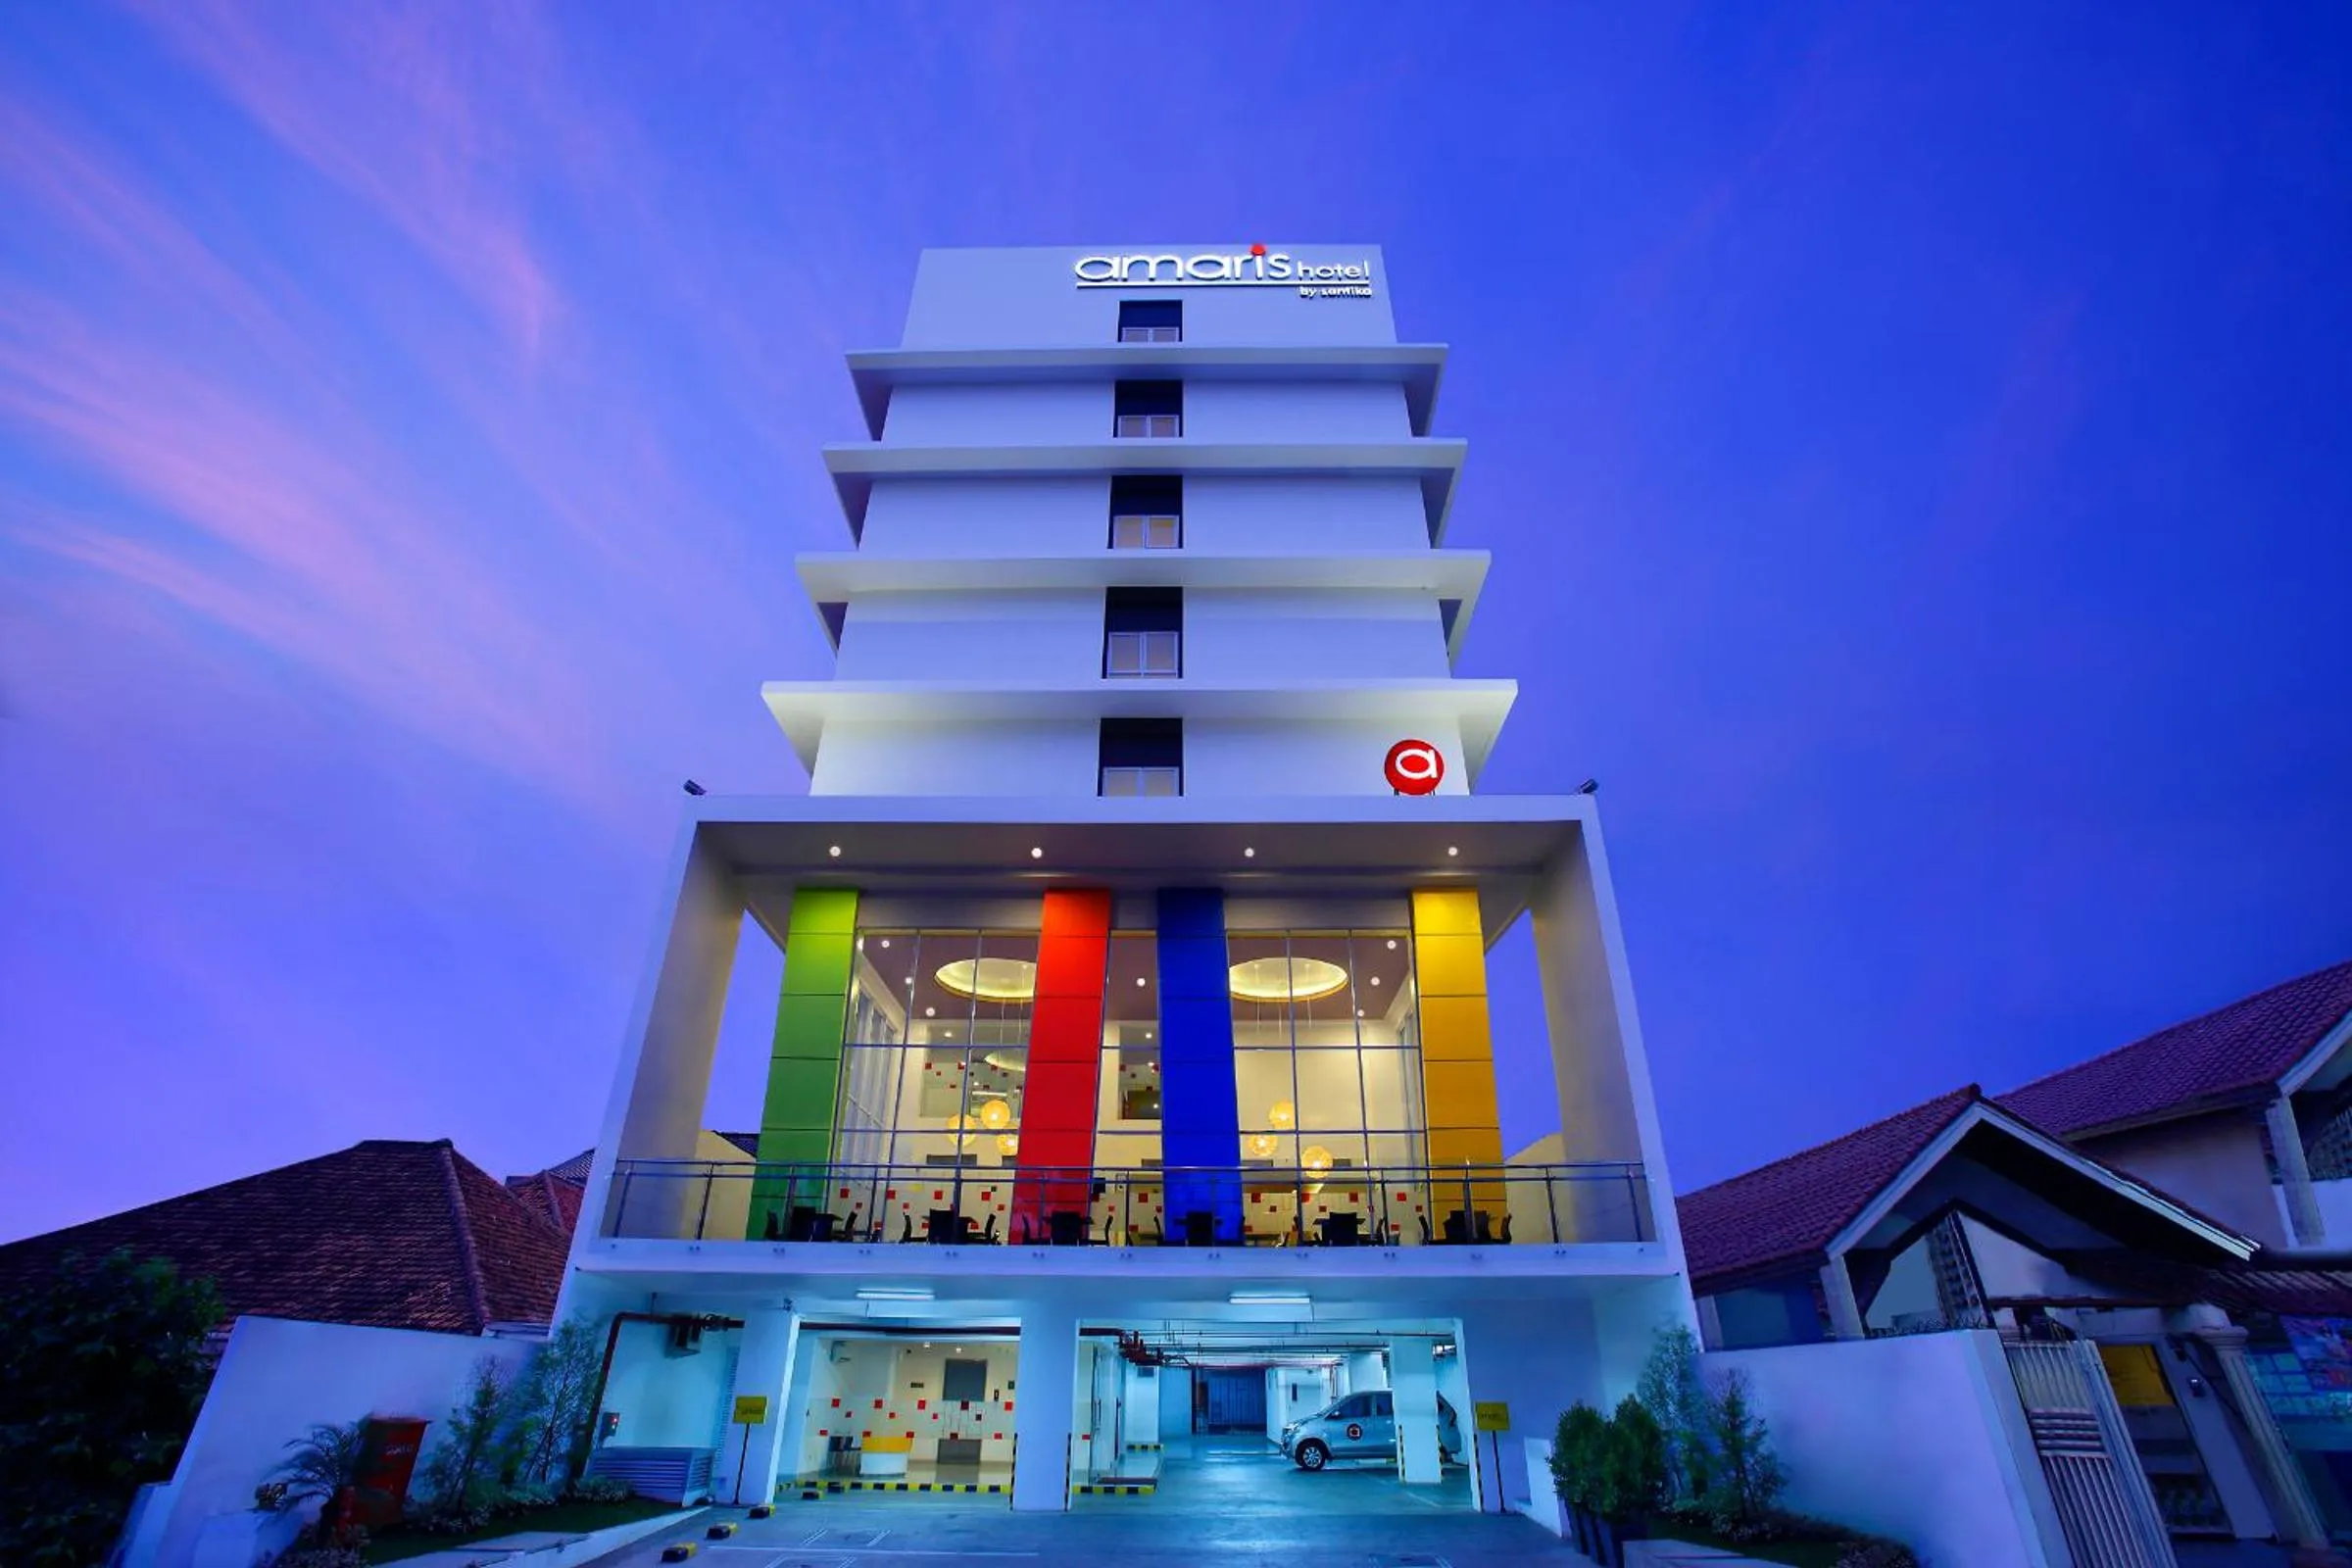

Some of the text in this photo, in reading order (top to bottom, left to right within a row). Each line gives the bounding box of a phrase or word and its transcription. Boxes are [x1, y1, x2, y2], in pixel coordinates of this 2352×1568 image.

[1074, 244, 1369, 281] amaris hotel
[1299, 286, 1317, 299] by
[1396, 749, 1438, 779] a
